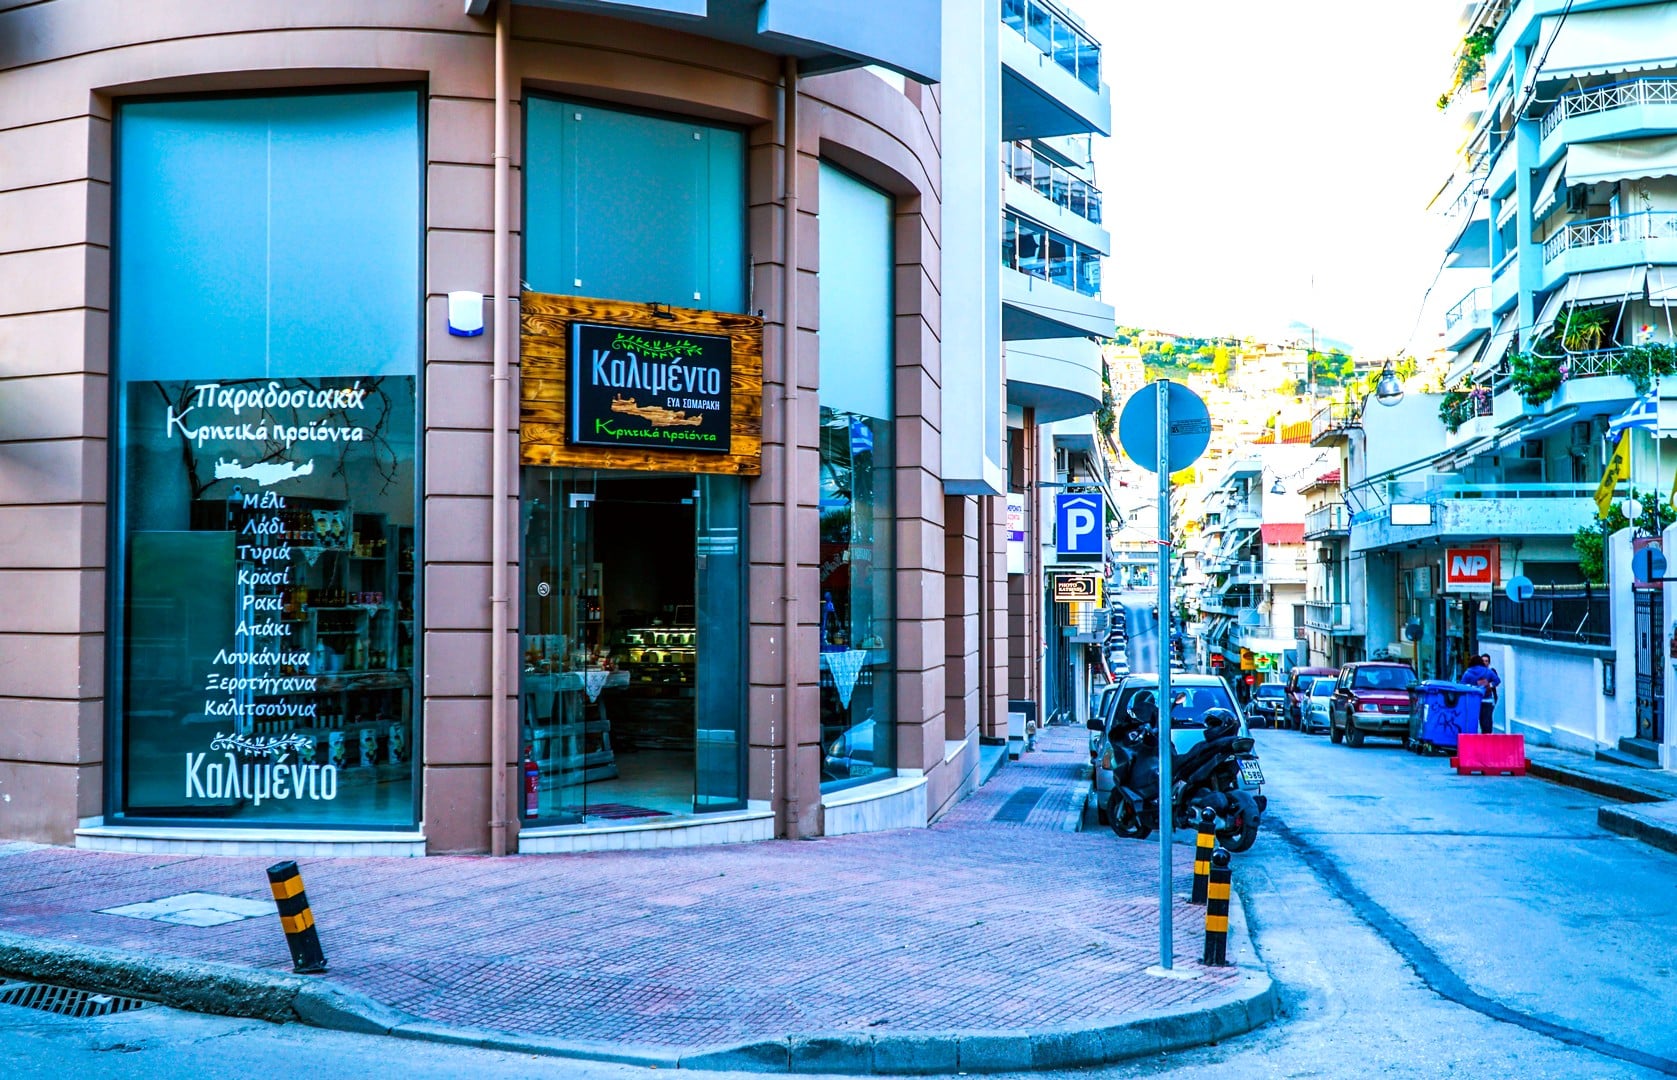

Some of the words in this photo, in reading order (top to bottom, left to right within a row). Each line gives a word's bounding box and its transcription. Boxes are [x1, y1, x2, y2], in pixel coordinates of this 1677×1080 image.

[592, 350, 721, 395] Καλιμέντο
[194, 381, 365, 415] Παραδοσιακά
[667, 397, 681, 408] ΕΥΑ
[682, 398, 720, 411] ΣΟΜΑΡΑΚΗ
[167, 405, 268, 448] Κρητικά
[273, 420, 364, 449] προϊόντα
[595, 418, 660, 439] Κρητικά
[243, 490, 286, 509] Μέλι
[242, 515, 286, 535] Λάδι
[1067, 508, 1095, 550] P
[237, 541, 291, 565] Τυριά
[1451, 555, 1488, 577] NP
[237, 566, 290, 590] Κρασί
[243, 591, 284, 611] Ρακί
[235, 617, 292, 637] Απάκι
[212, 646, 310, 666] Λουκάνικα
[205, 672, 317, 695] Ξεροτήγανα
[204, 698, 317, 718] Καλιτσούνια
[185, 752, 337, 806] Καλιμέντο
